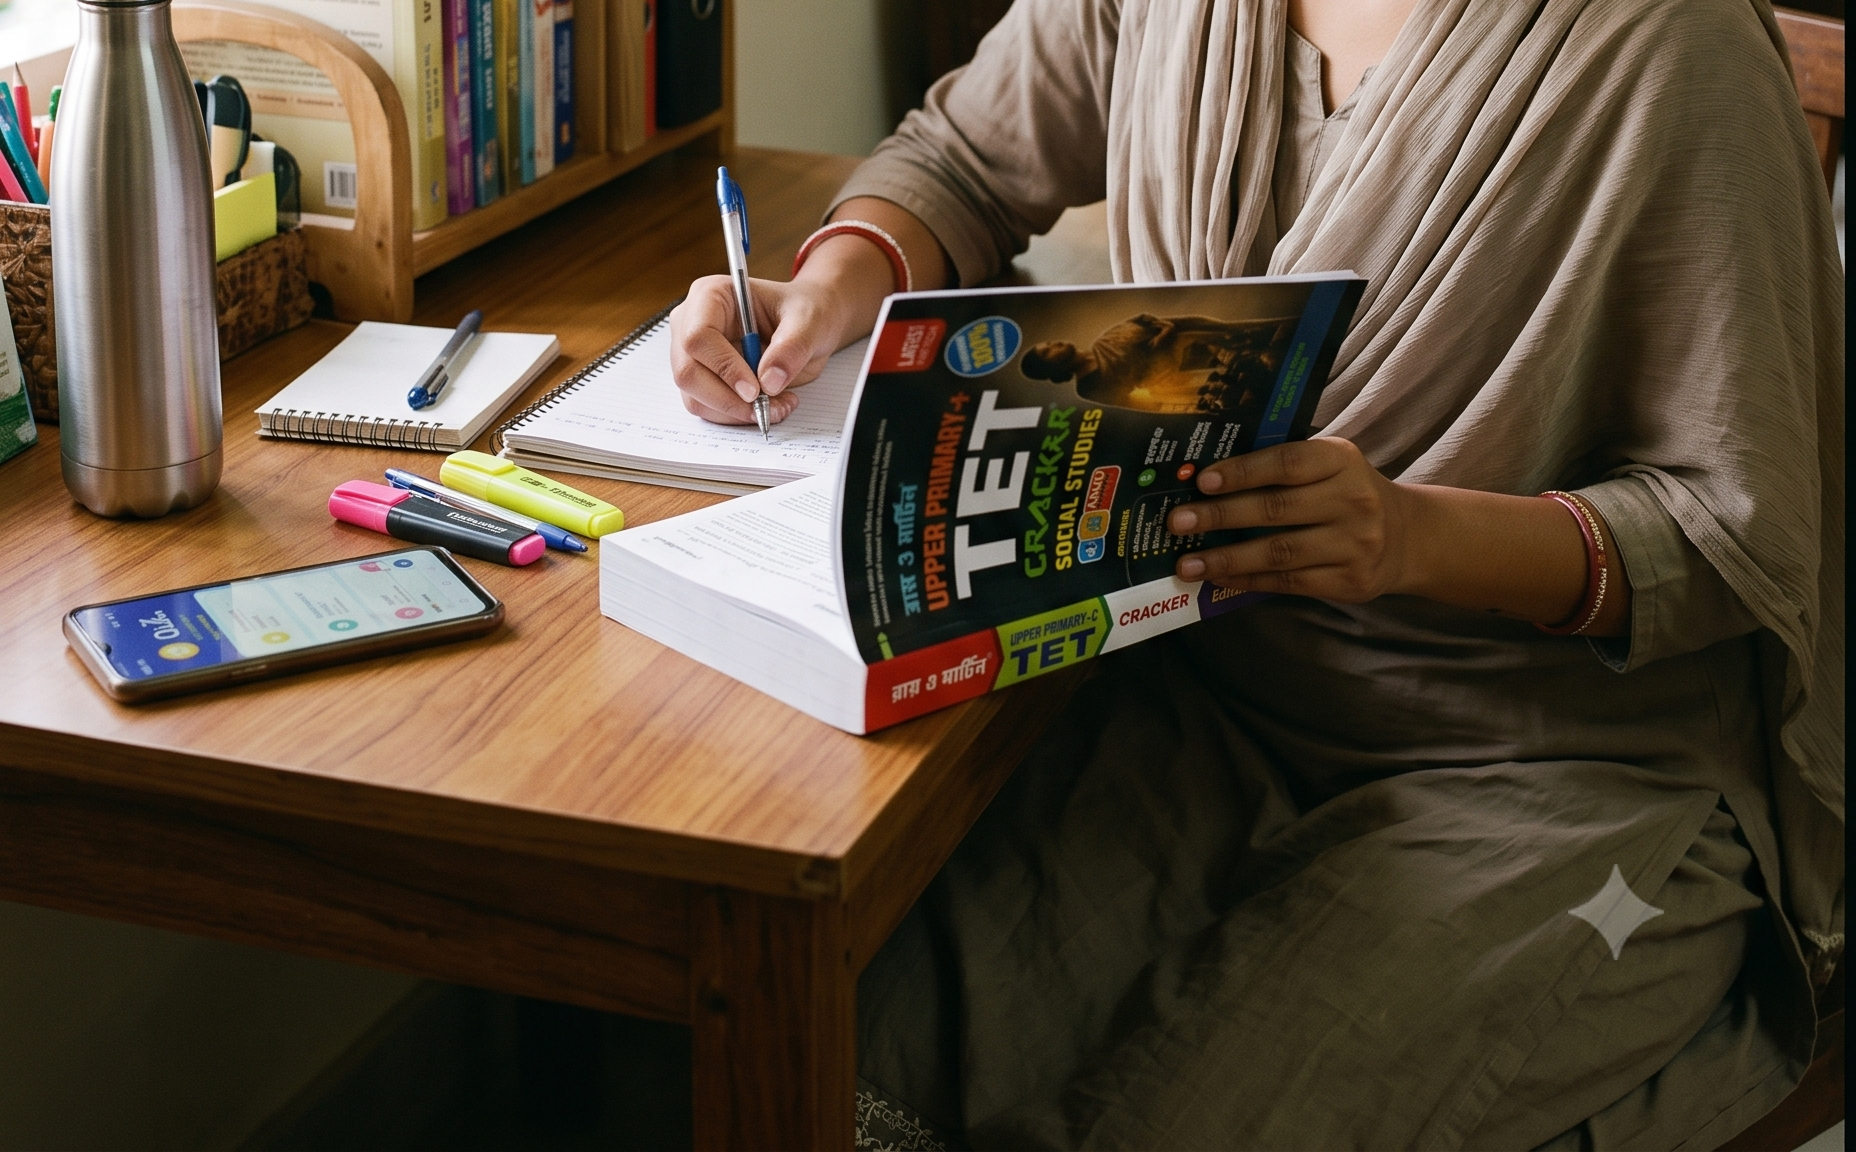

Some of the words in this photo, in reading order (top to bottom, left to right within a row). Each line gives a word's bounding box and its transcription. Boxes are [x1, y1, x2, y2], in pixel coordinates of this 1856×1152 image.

[1064, 408, 1103, 492] STUDIES
[954, 390, 1042, 600] TET
[923, 522, 950, 611] UPPER
[1055, 496, 1079, 571] SOCIAL
[1010, 628, 1041, 646] UPPER
[1119, 593, 1189, 626] CRACKER
[1010, 627, 1096, 676] TET
